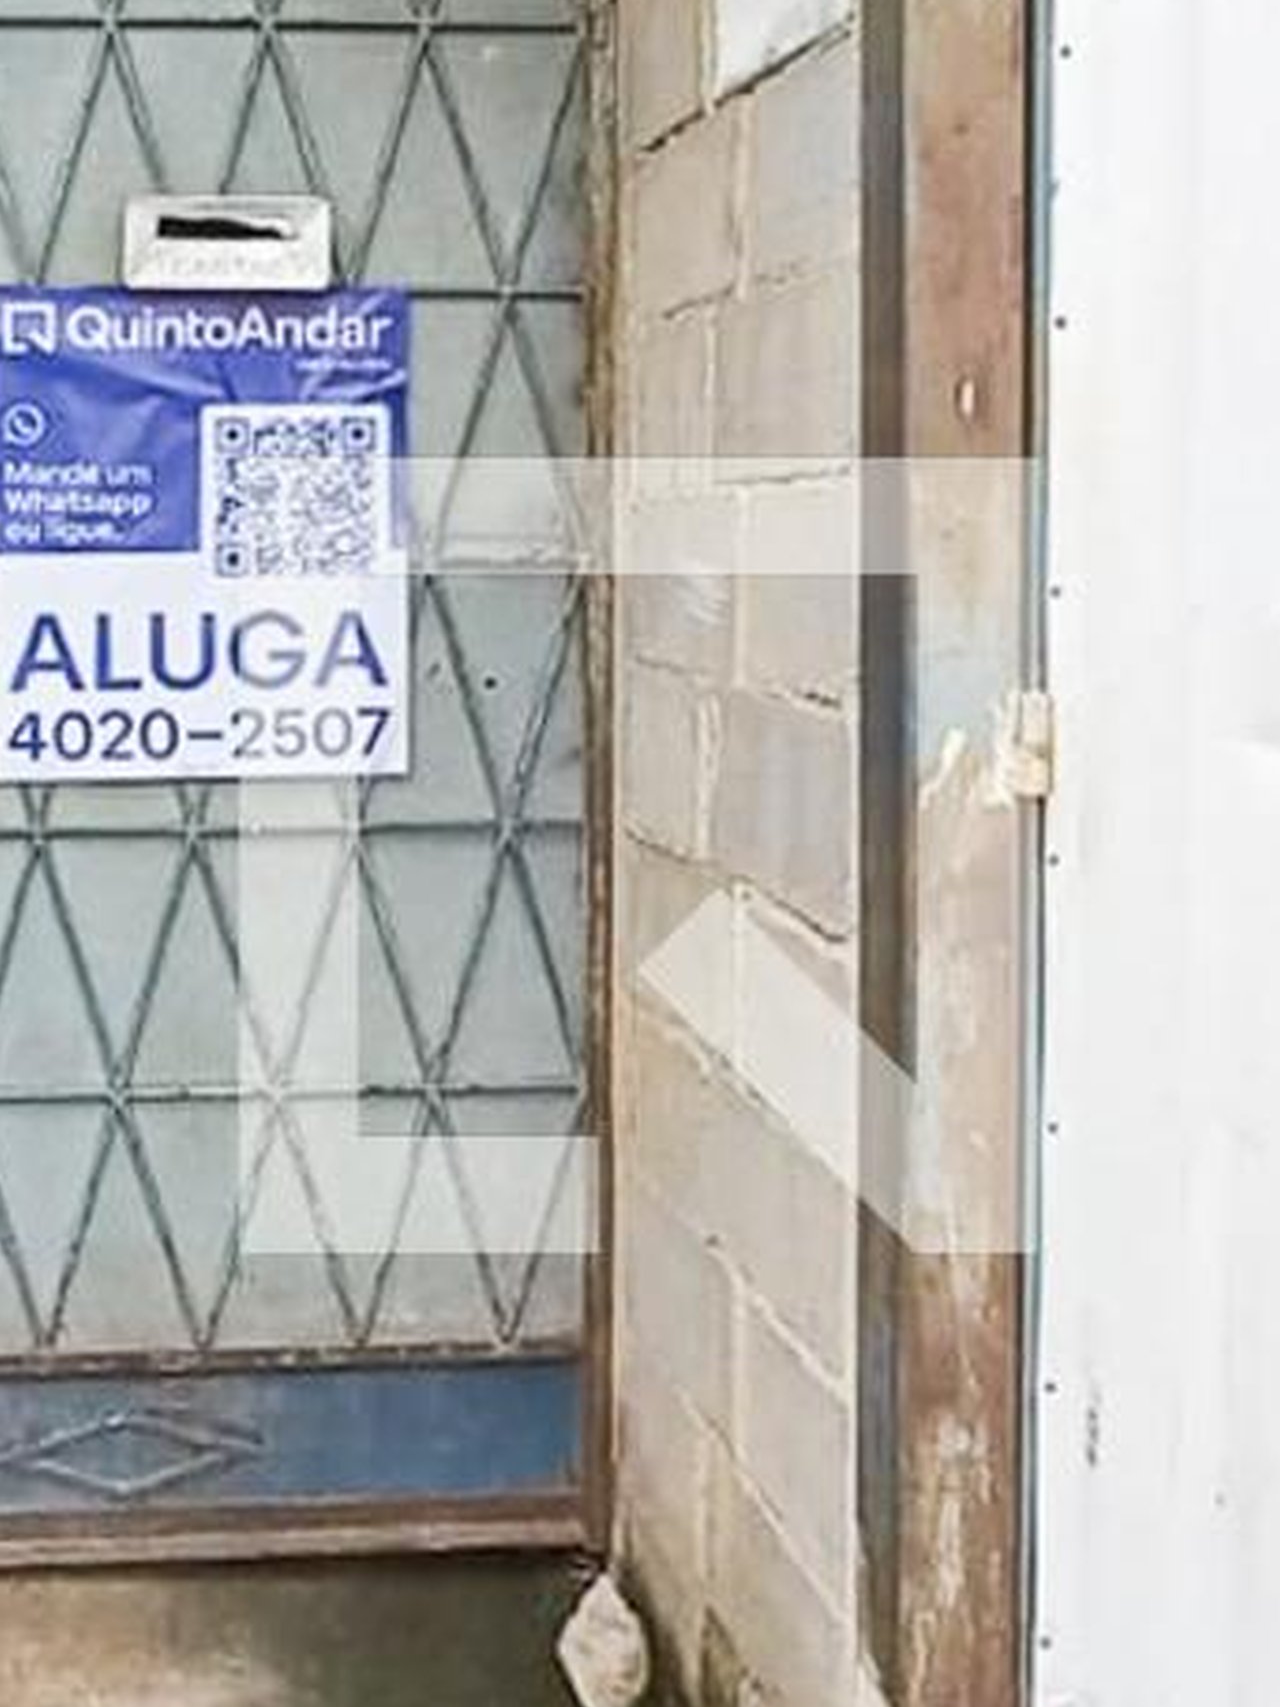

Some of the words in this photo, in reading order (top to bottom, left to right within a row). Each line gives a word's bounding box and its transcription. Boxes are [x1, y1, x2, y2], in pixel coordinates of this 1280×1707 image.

[65, 305, 393, 352] QuintoAndar
[105, 464, 154, 486] um
[4, 521, 42, 544] ou
[9, 608, 390, 692] ALUGA
[6, 706, 392, 762] 4020-2507
